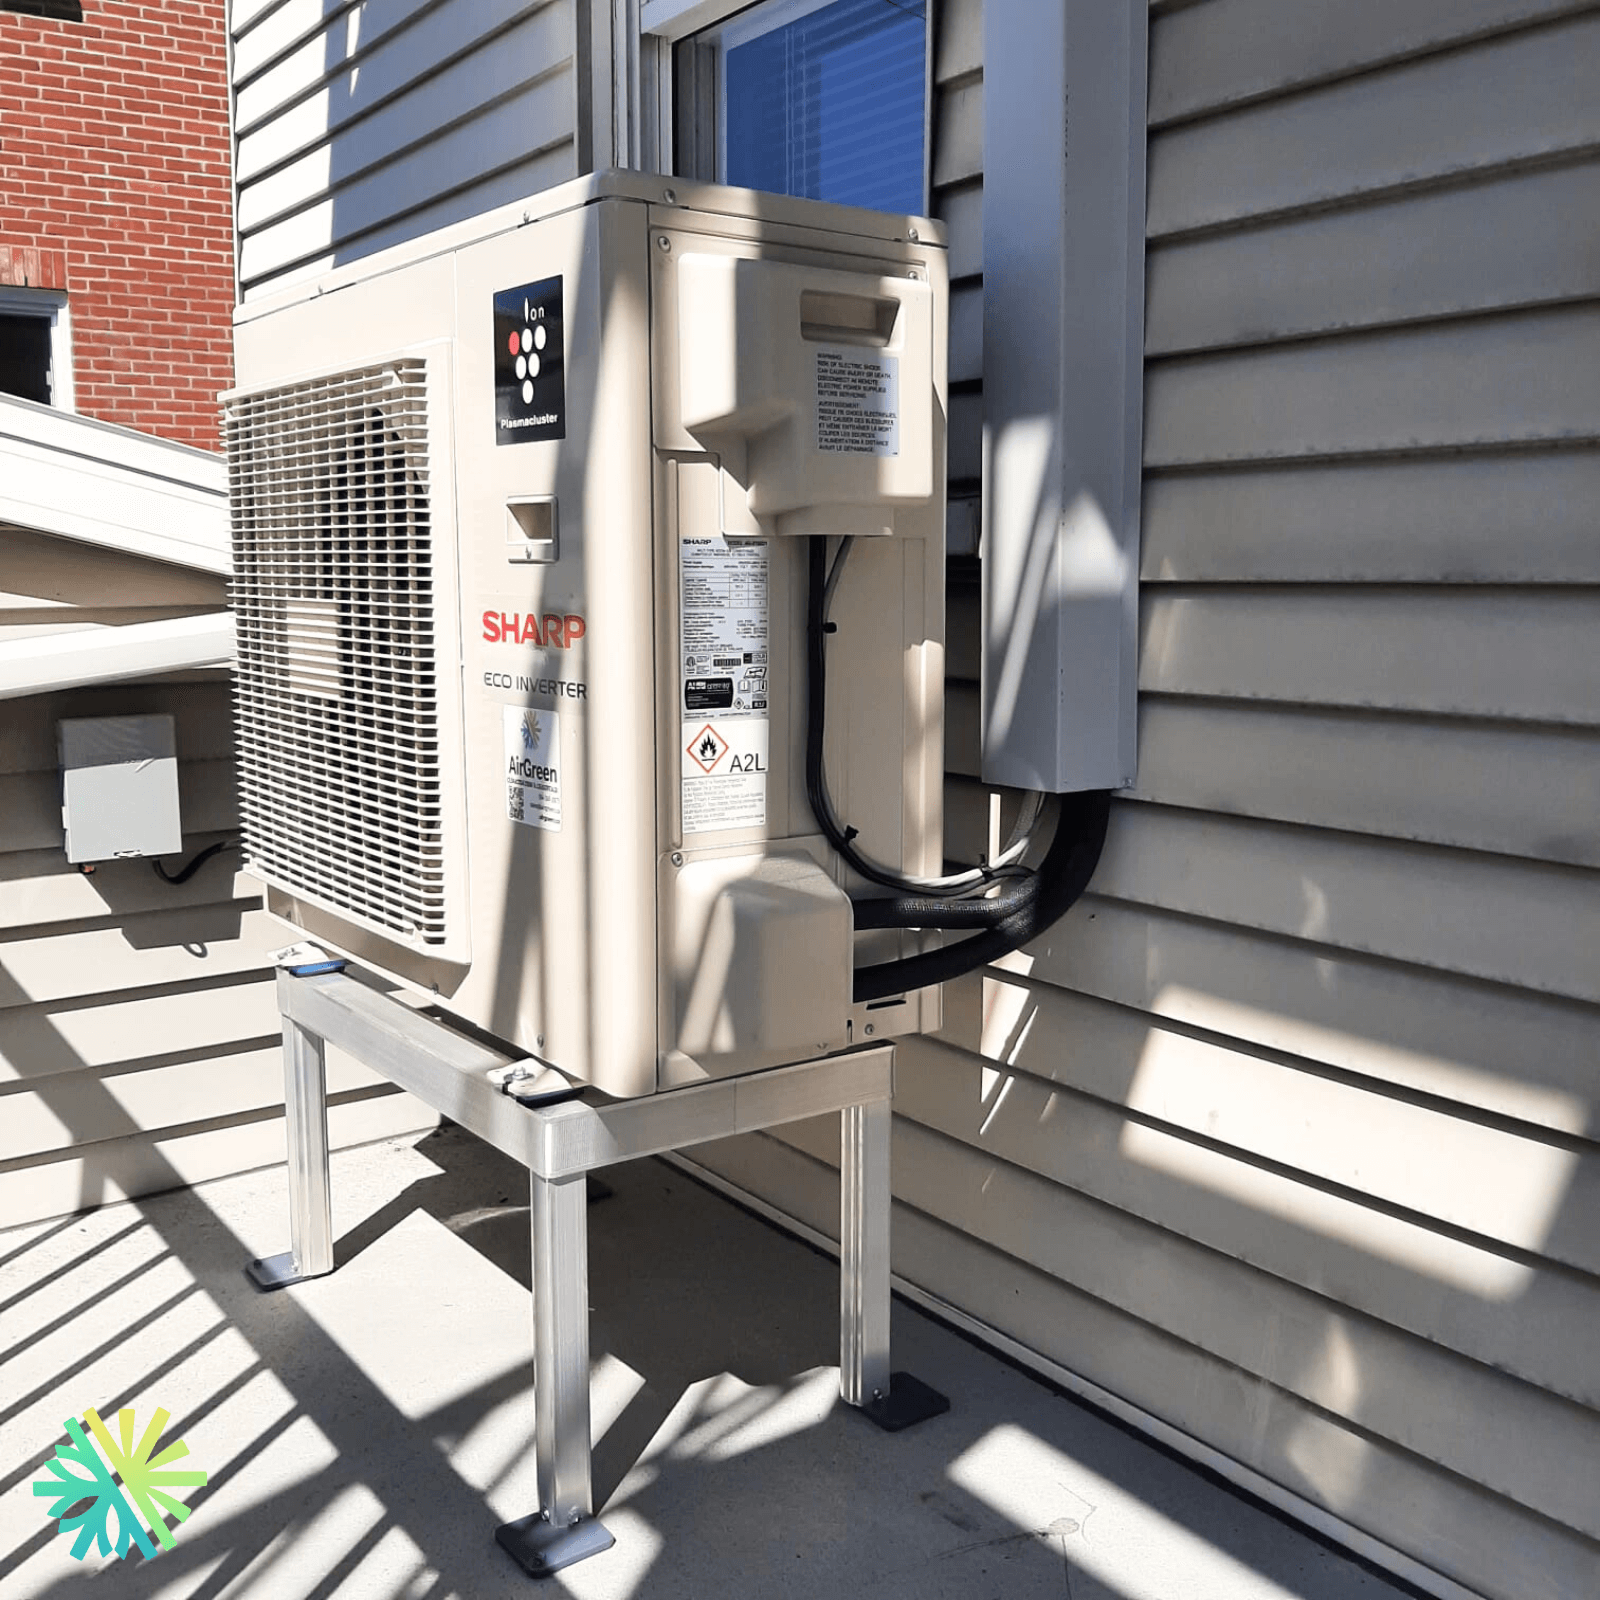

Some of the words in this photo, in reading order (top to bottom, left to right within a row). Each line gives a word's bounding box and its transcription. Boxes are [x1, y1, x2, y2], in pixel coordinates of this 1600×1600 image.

[501, 413, 558, 429] Plasmacluster
[482, 610, 586, 649] SHARP
[484, 672, 512, 689] ECO
[516, 676, 587, 700] INVERTER
[508, 755, 558, 783] AirGreen
[729, 753, 766, 773] A2L
